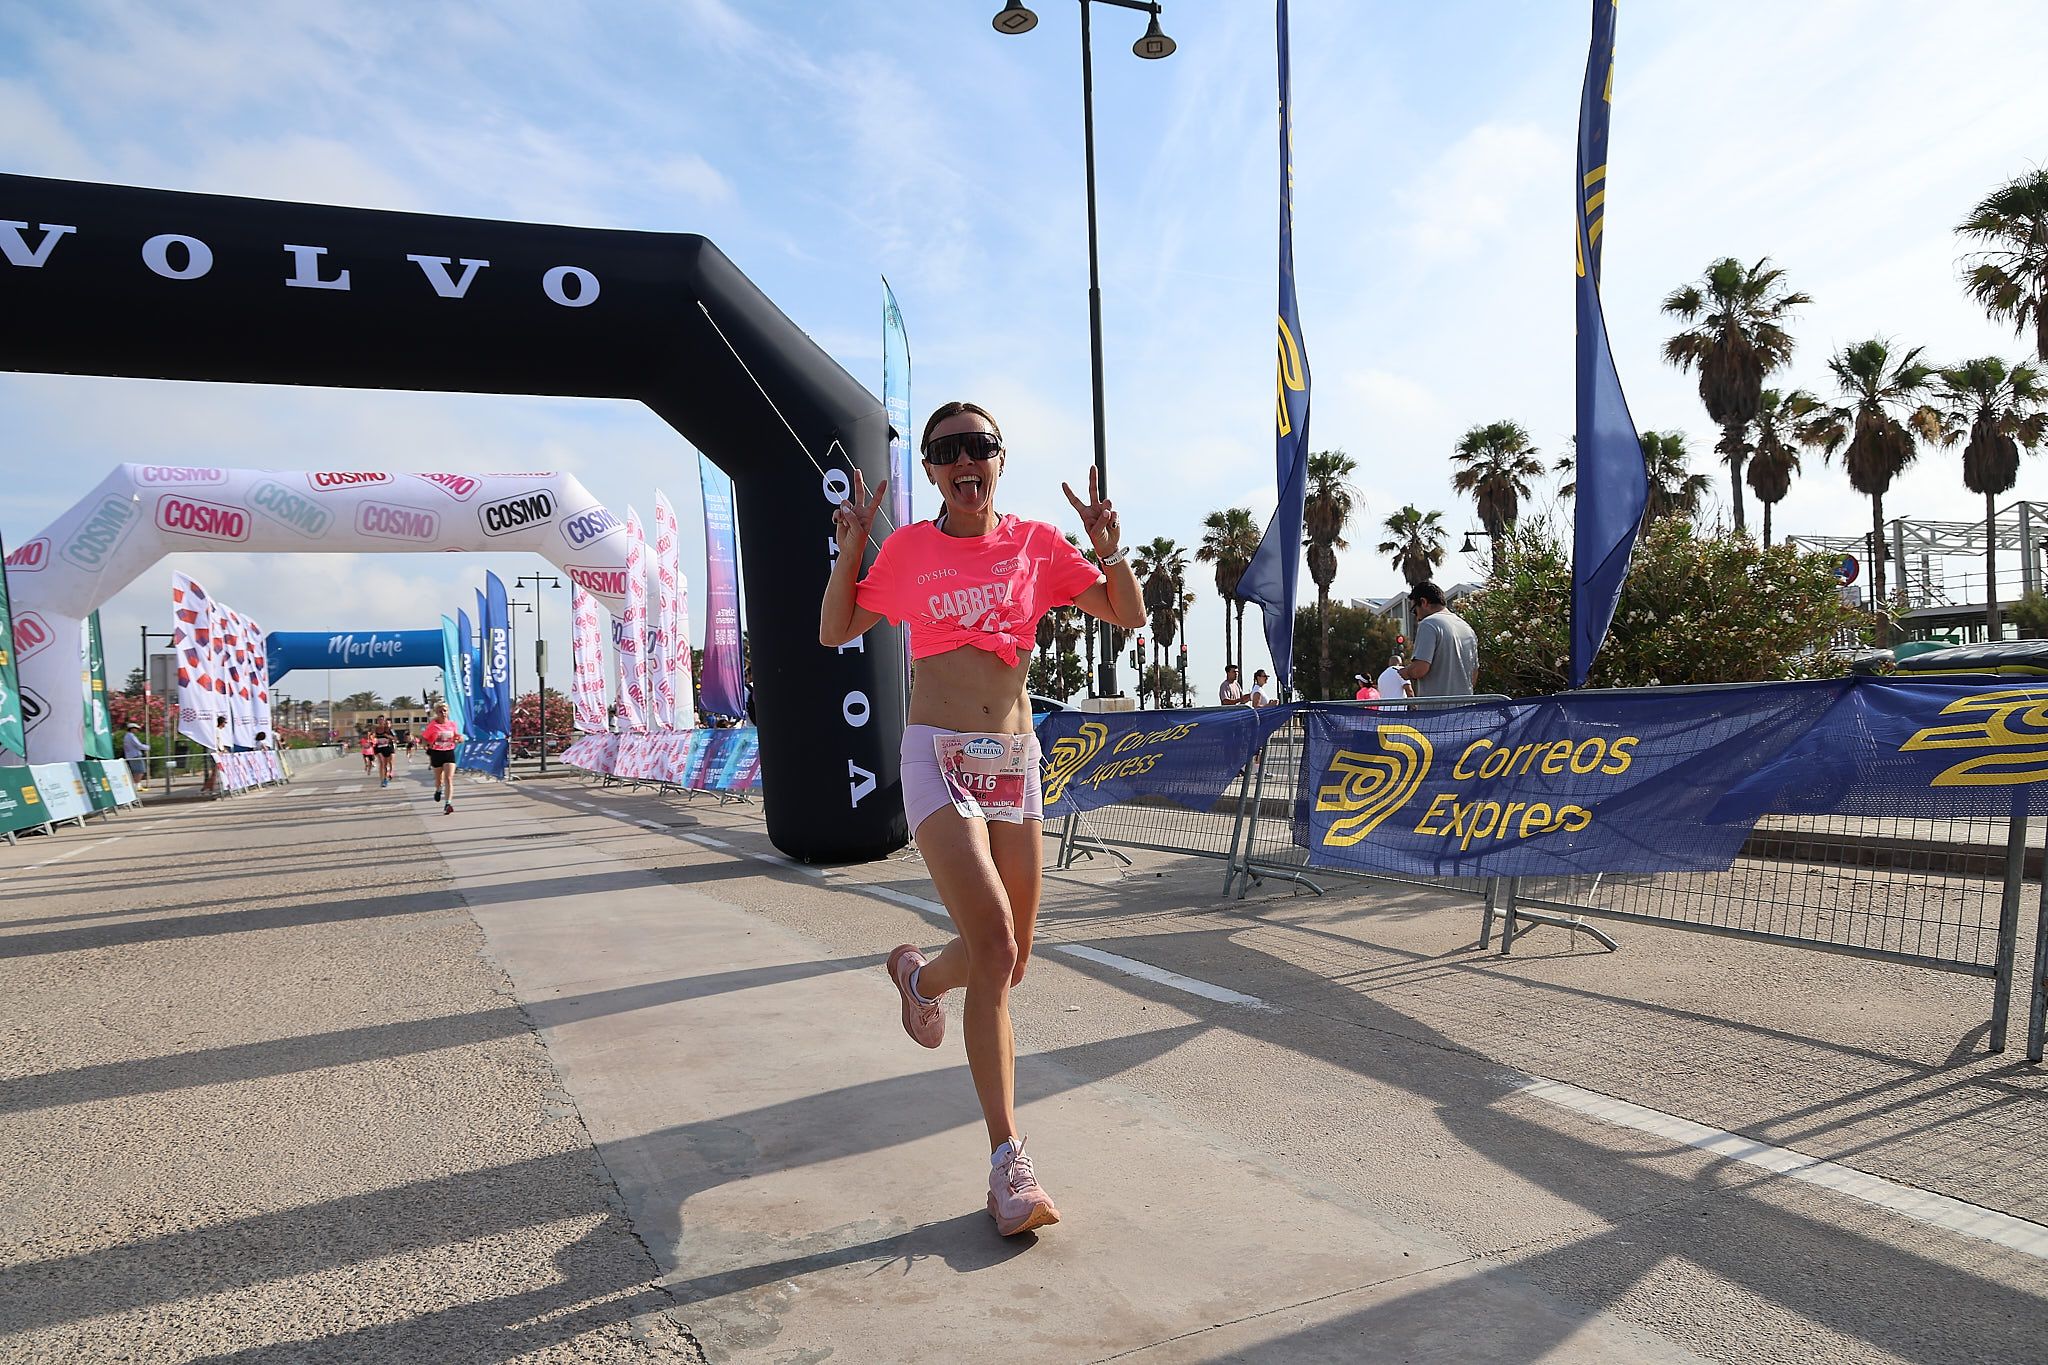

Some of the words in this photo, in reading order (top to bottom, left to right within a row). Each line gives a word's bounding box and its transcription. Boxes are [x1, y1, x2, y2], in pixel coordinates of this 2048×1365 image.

[0, 219, 601, 307] VOLVO
[143, 466, 221, 482] COSMO
[316, 471, 386, 486] COSMO
[165, 500, 243, 537] COSMO
[254, 483, 327, 533] COSMO
[363, 505, 434, 538] COSMO
[486, 494, 551, 531] COSMO
[69, 499, 134, 564] COSMO
[570, 569, 627, 594] COSMO
[917, 568, 958, 585] OYSHO
[928, 582, 1009, 620] CARRER
[328, 634, 403, 663] Marlene
[966, 746, 1002, 755] ASTURIANA
[1452, 736, 1640, 780] Correos
[1080, 753, 1163, 790] xpress
